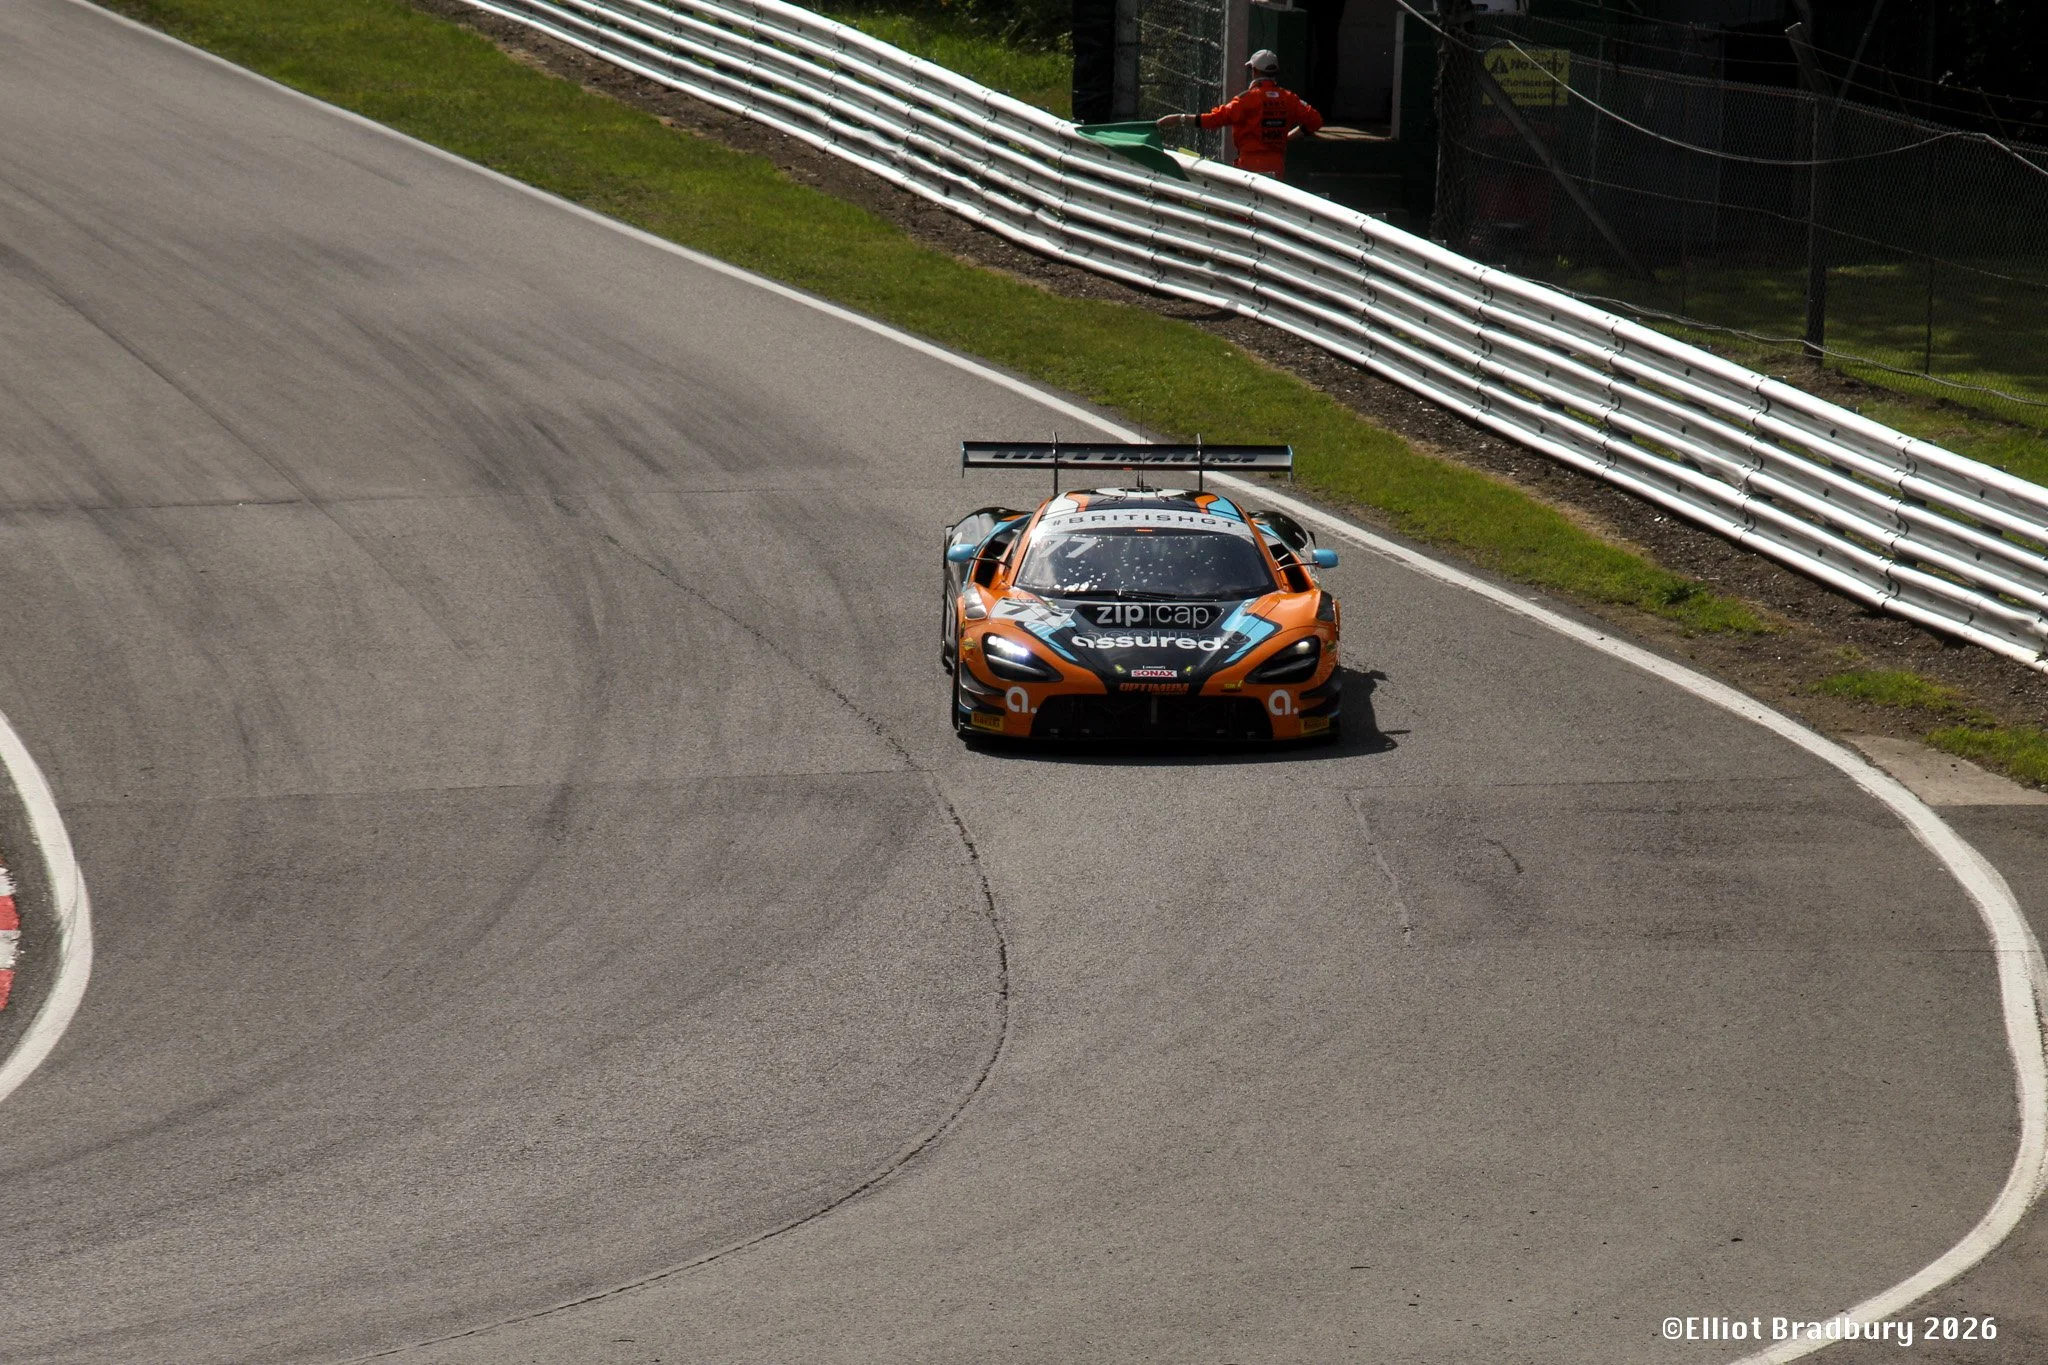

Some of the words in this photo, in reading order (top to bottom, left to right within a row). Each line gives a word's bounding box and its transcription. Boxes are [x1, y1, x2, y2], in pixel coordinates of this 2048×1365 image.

[1096, 604, 1145, 627] zip
[1156, 605, 1209, 629] cap
[1071, 635, 1230, 651] assured.
[1133, 669, 1175, 677] SONAX
[1120, 682, 1190, 693] OPTIMUM
